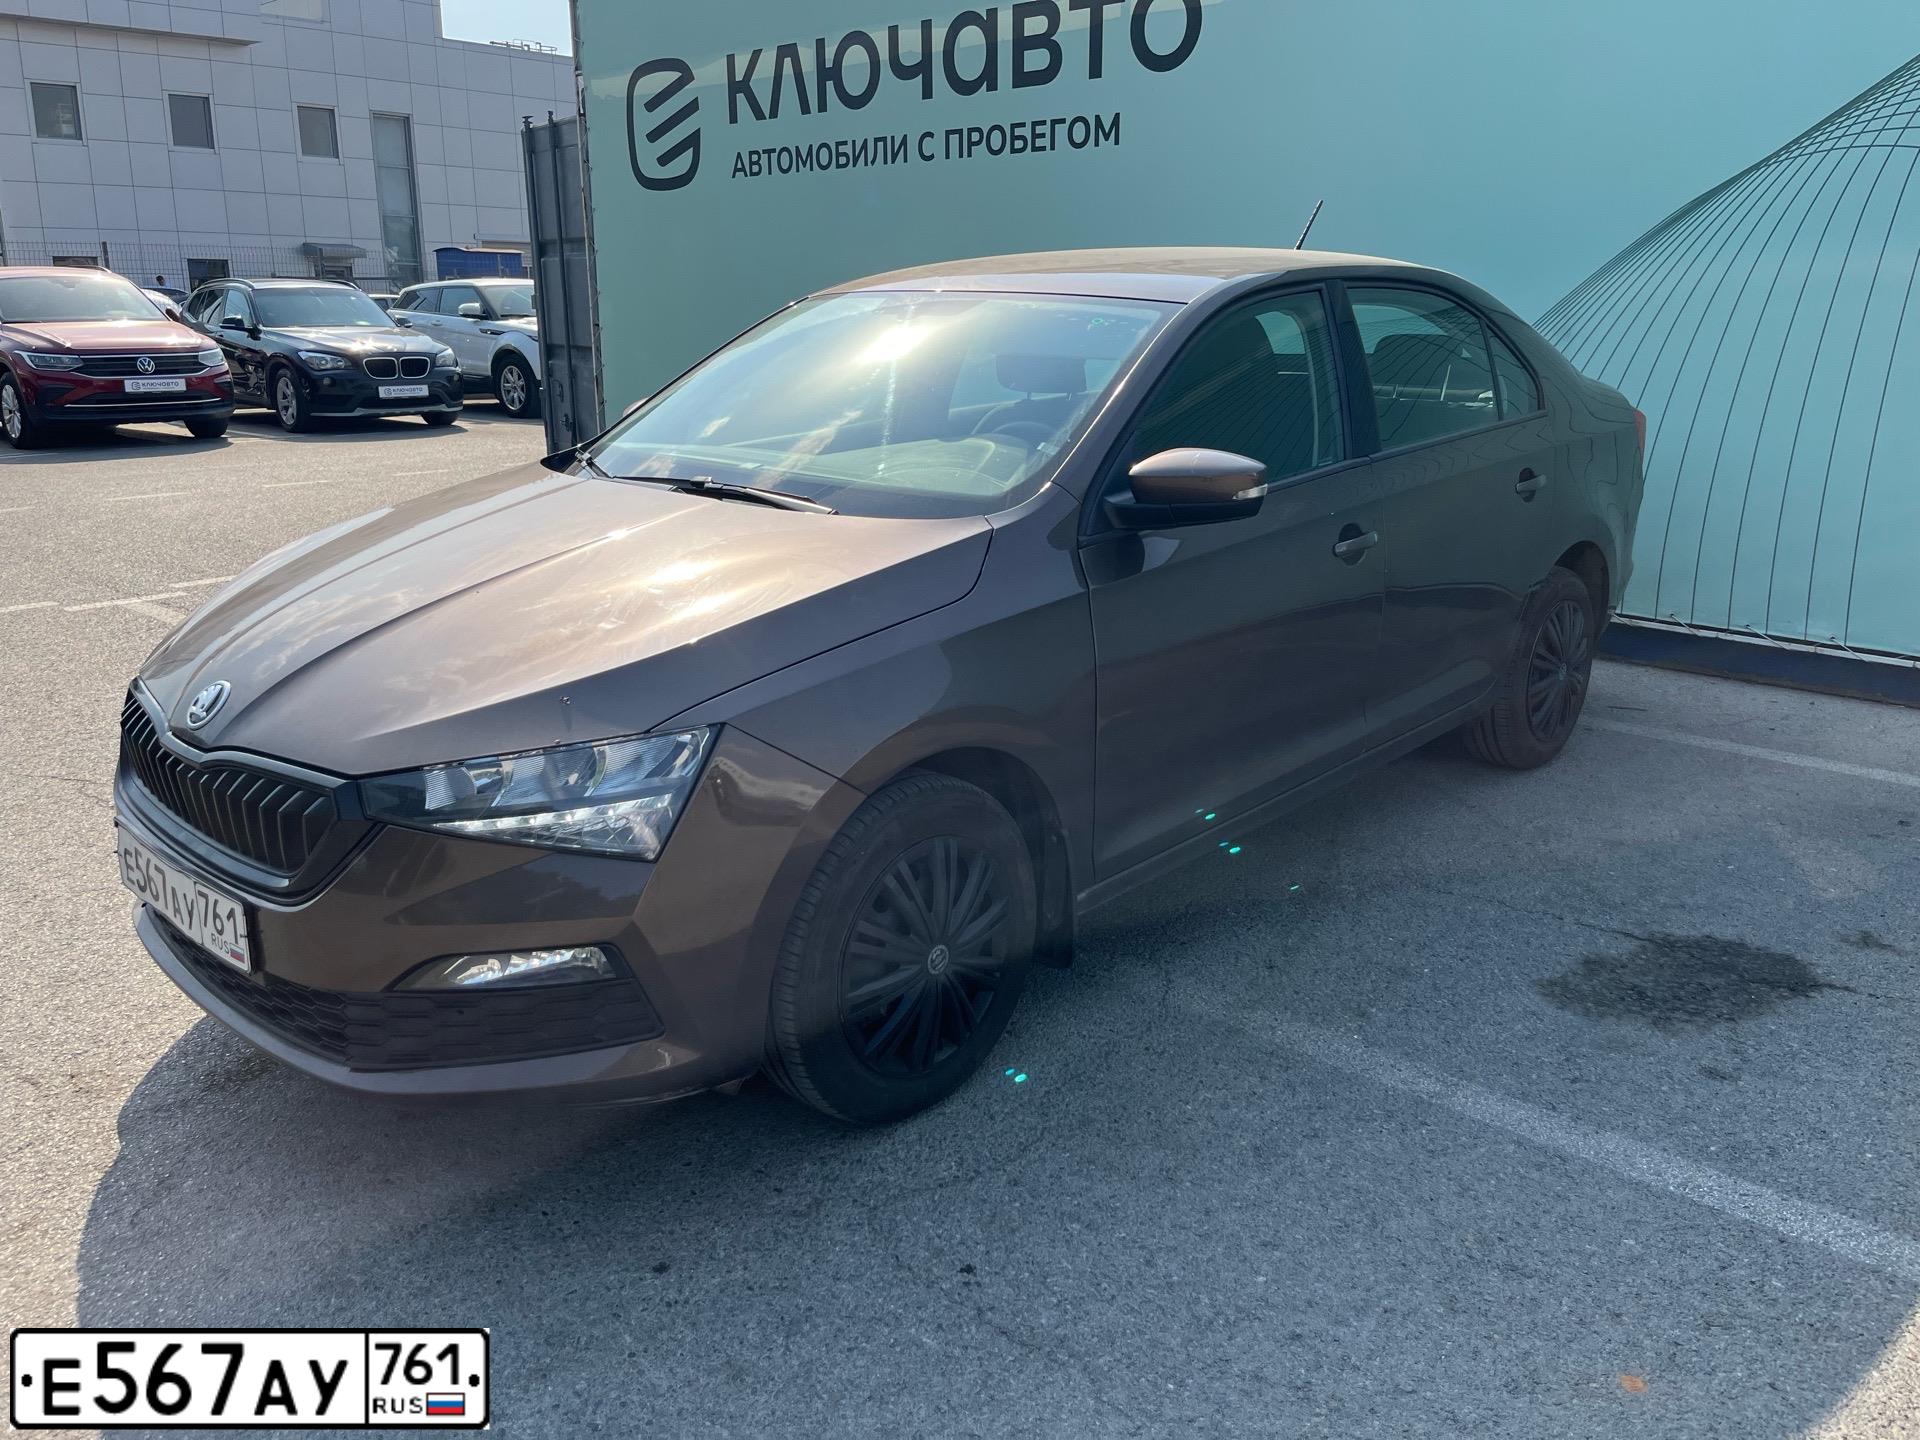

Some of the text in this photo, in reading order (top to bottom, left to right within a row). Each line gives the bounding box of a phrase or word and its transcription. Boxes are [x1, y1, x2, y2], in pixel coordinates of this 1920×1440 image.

[731, 112, 1121, 178] АВТОМОБИЛИ С ПРОБЕГОМ
[198, 890, 239, 945] 761
[211, 933, 230, 954] RUS
